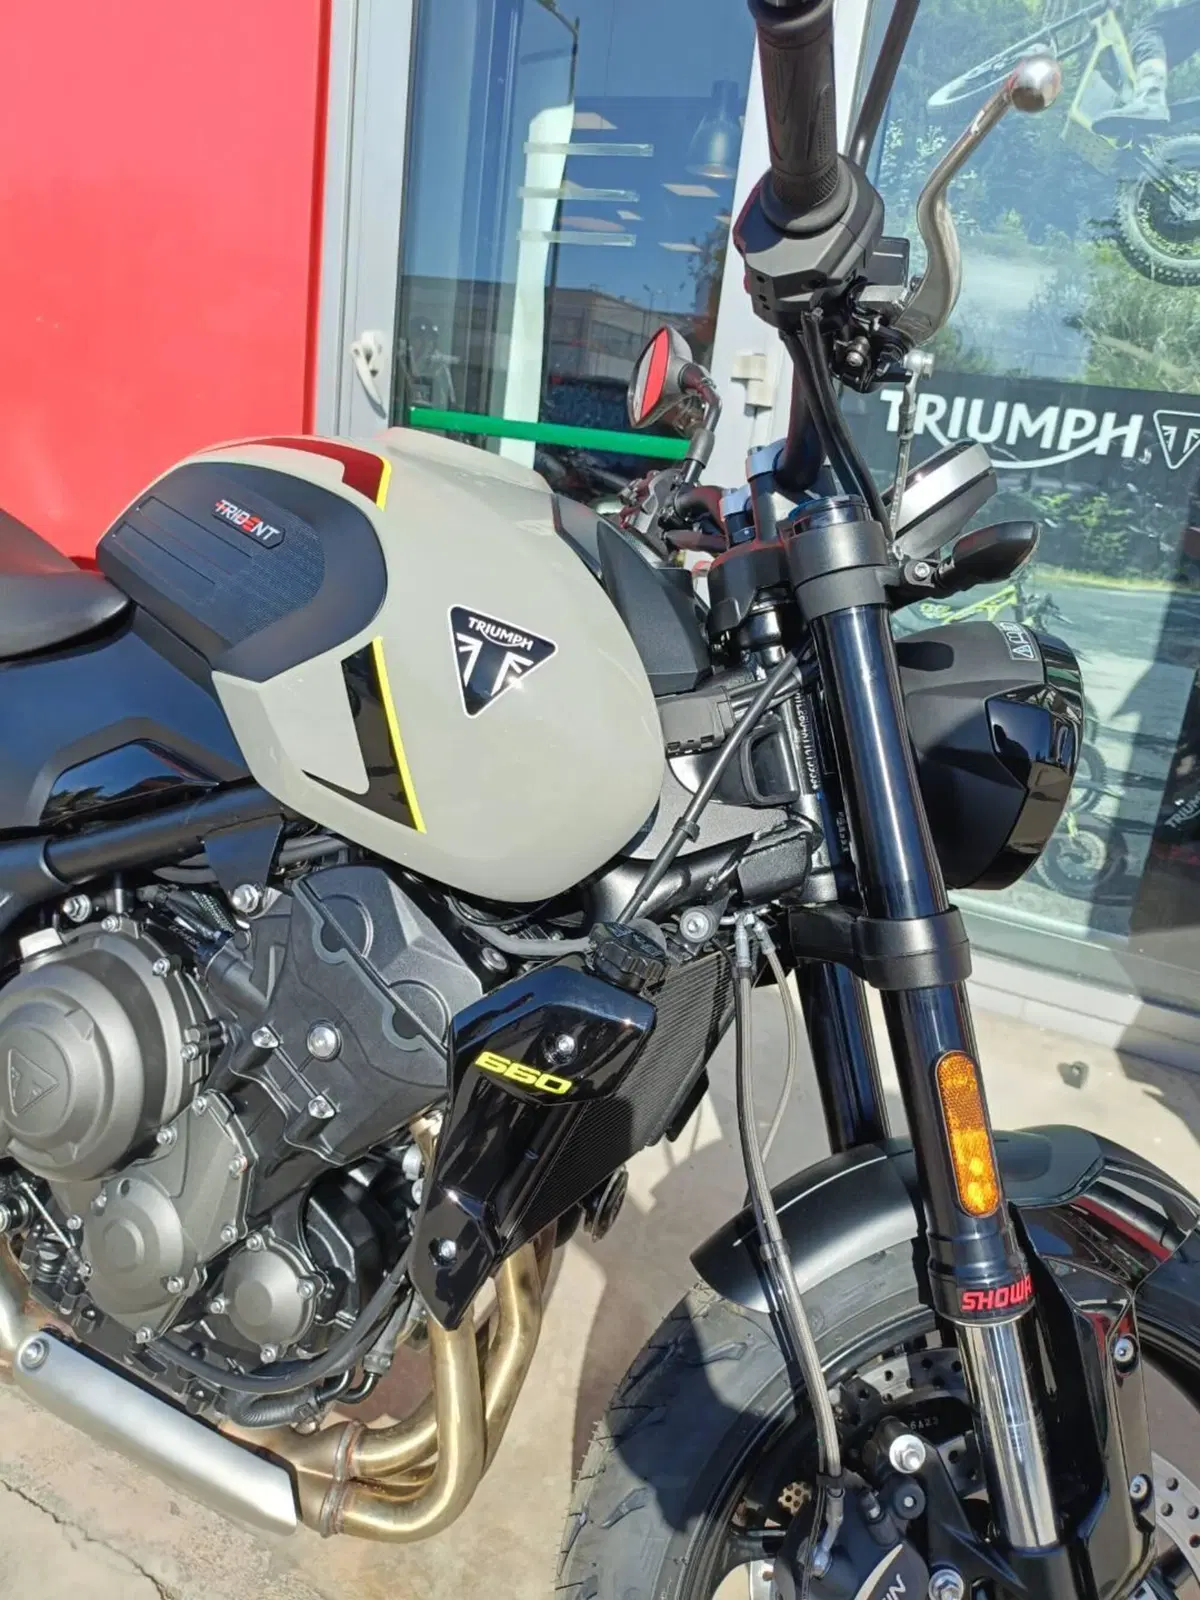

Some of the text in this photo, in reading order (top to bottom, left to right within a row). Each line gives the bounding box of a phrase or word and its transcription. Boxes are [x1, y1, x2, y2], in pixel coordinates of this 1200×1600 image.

[880, 389, 1144, 468] TRIUMPH
[215, 499, 280, 540] TRIDENT
[468, 616, 534, 651] TRIUMPH
[1164, 791, 1200, 828] TRIUM
[475, 1051, 572, 1094] 660
